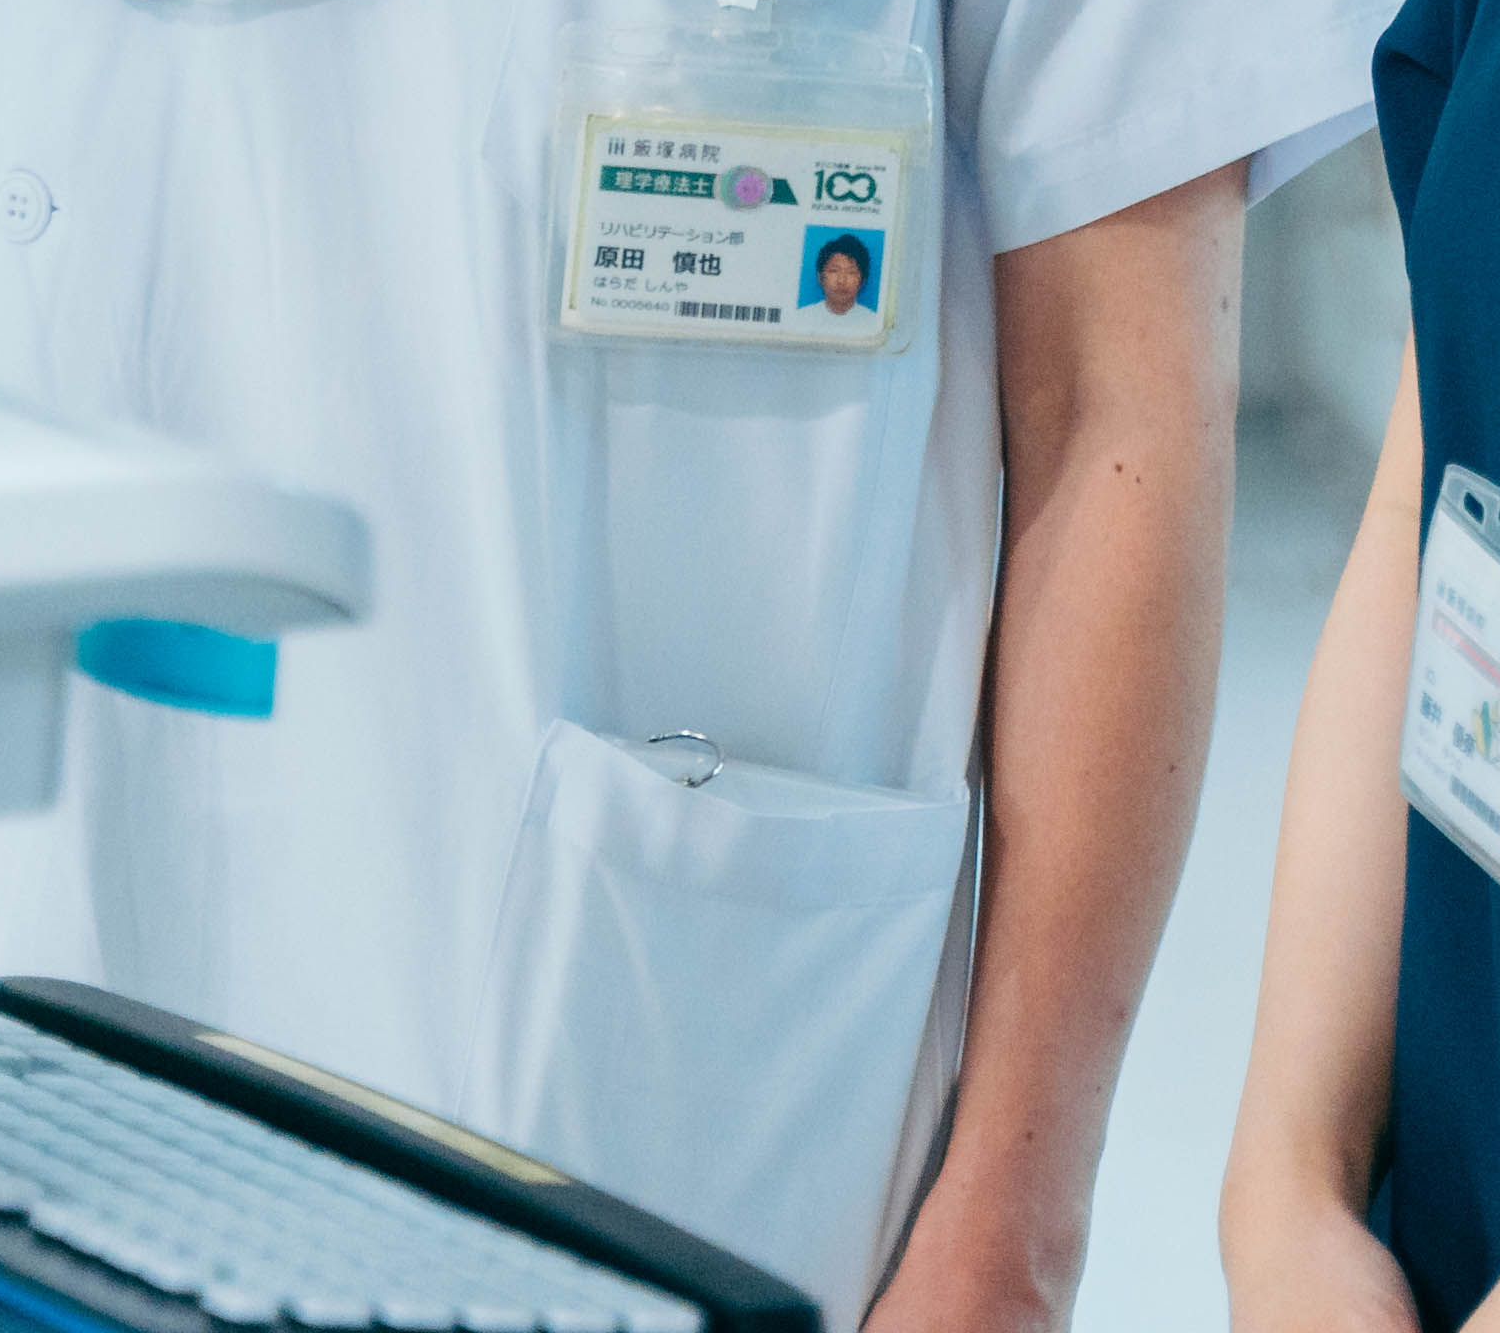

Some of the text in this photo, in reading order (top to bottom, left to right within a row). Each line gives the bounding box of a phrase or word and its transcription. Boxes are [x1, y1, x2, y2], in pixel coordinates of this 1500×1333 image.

[633, 139, 721, 164] 飯塚病院
[614, 171, 710, 194] 理学療法士
[594, 245, 723, 276] 原田 慎也
